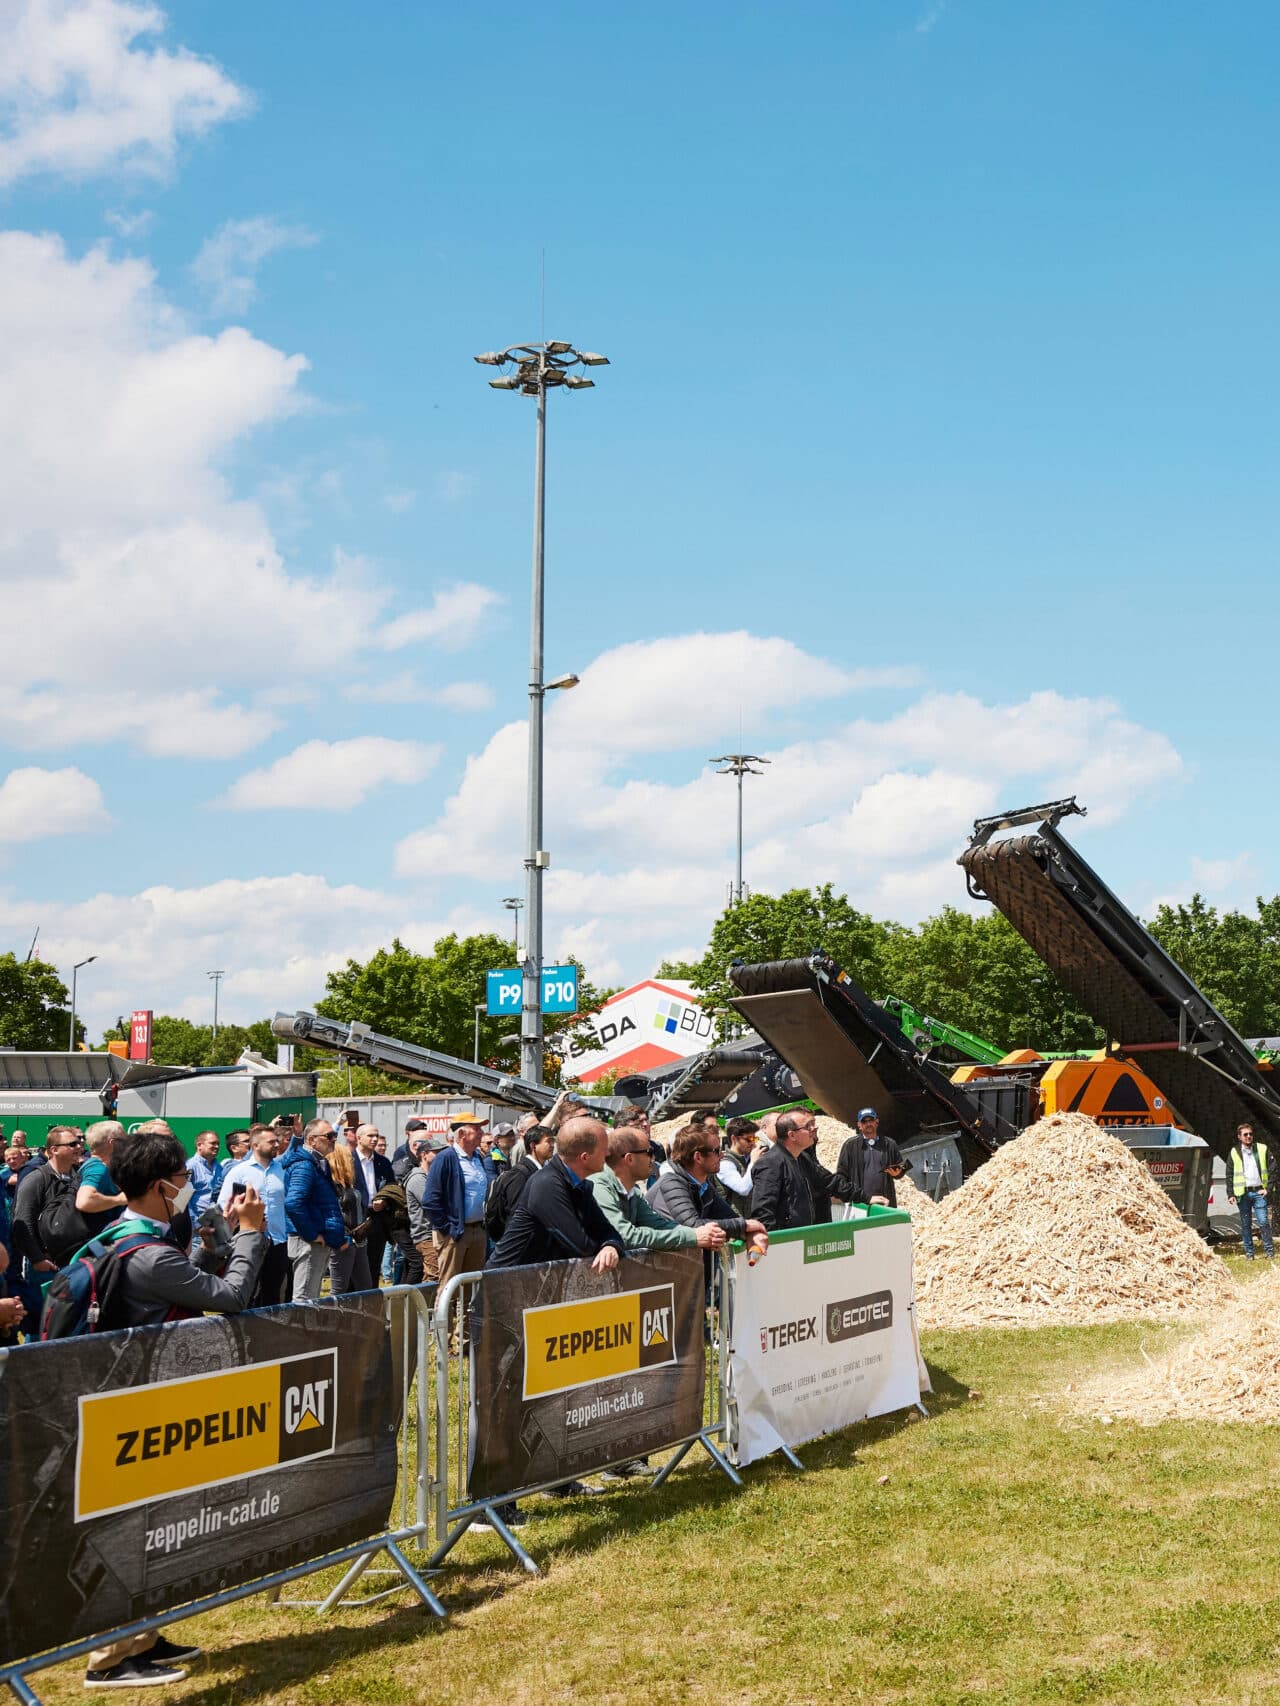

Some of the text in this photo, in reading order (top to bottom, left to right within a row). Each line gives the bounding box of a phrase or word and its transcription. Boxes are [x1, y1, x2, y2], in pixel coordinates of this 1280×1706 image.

[499, 984, 521, 1005] P9
[544, 981, 575, 1003] P10
[1150, 1163, 1180, 1175] MONDIS
[806, 1245, 817, 1256] HALL
[544, 1307, 670, 1363] ZEPPELIN CAT
[768, 1301, 890, 1349] TEREX ECOTEC
[115, 1379, 329, 1467] ZEPPELIN CAT
[565, 1387, 645, 1429] zeppelin-cat.de
[145, 1490, 281, 1554] zeppelin-cat.de
